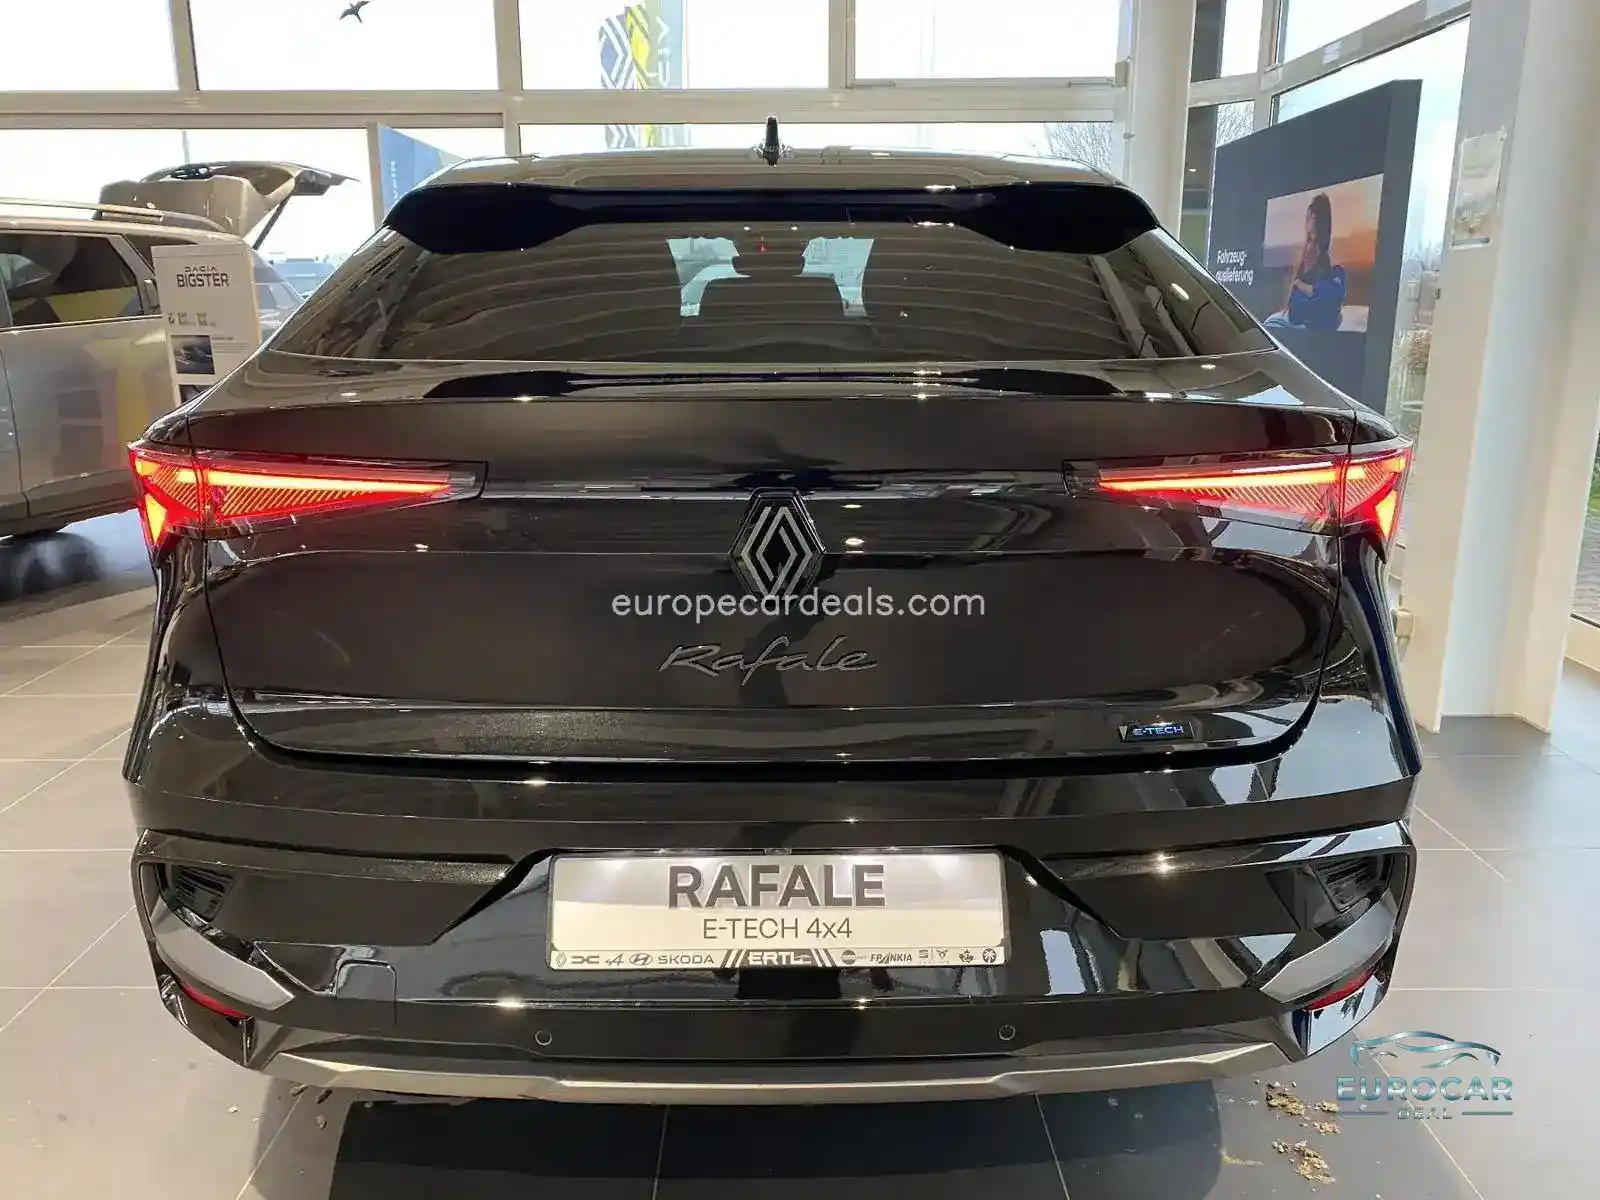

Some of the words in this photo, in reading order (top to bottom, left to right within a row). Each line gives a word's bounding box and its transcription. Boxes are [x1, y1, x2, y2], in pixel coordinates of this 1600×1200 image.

[1217, 249, 1248, 266] Fahrzeug-
[184, 265, 218, 273] DACIA
[176, 273, 229, 288] BIGSTER
[657, 634, 881, 686] Rafale
[1132, 726, 1184, 736] E-TECH
[668, 864, 886, 908] RAFALE
[703, 917, 798, 939] E-TECH
[806, 917, 852, 939] 4x4
